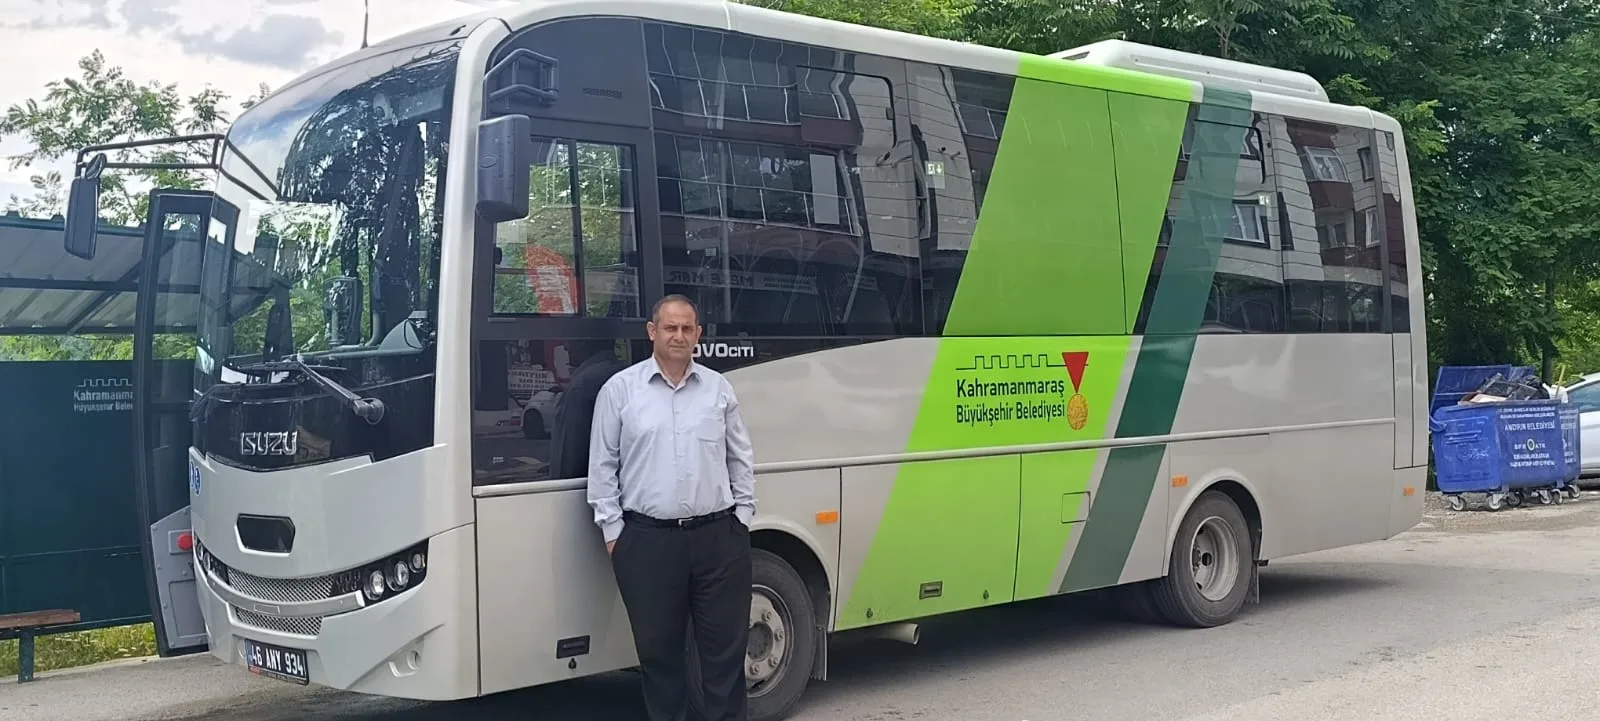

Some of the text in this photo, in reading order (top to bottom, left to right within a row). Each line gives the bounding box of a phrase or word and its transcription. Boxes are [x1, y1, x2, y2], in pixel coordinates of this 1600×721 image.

[692, 343, 754, 358] OVOCITI
[957, 378, 1065, 398] Kahramanmaraş
[956, 400, 1065, 427] Büyükşehir Belediyesi
[241, 431, 297, 455] ISUZU
[251, 645, 304, 676] 46 ANY 934
